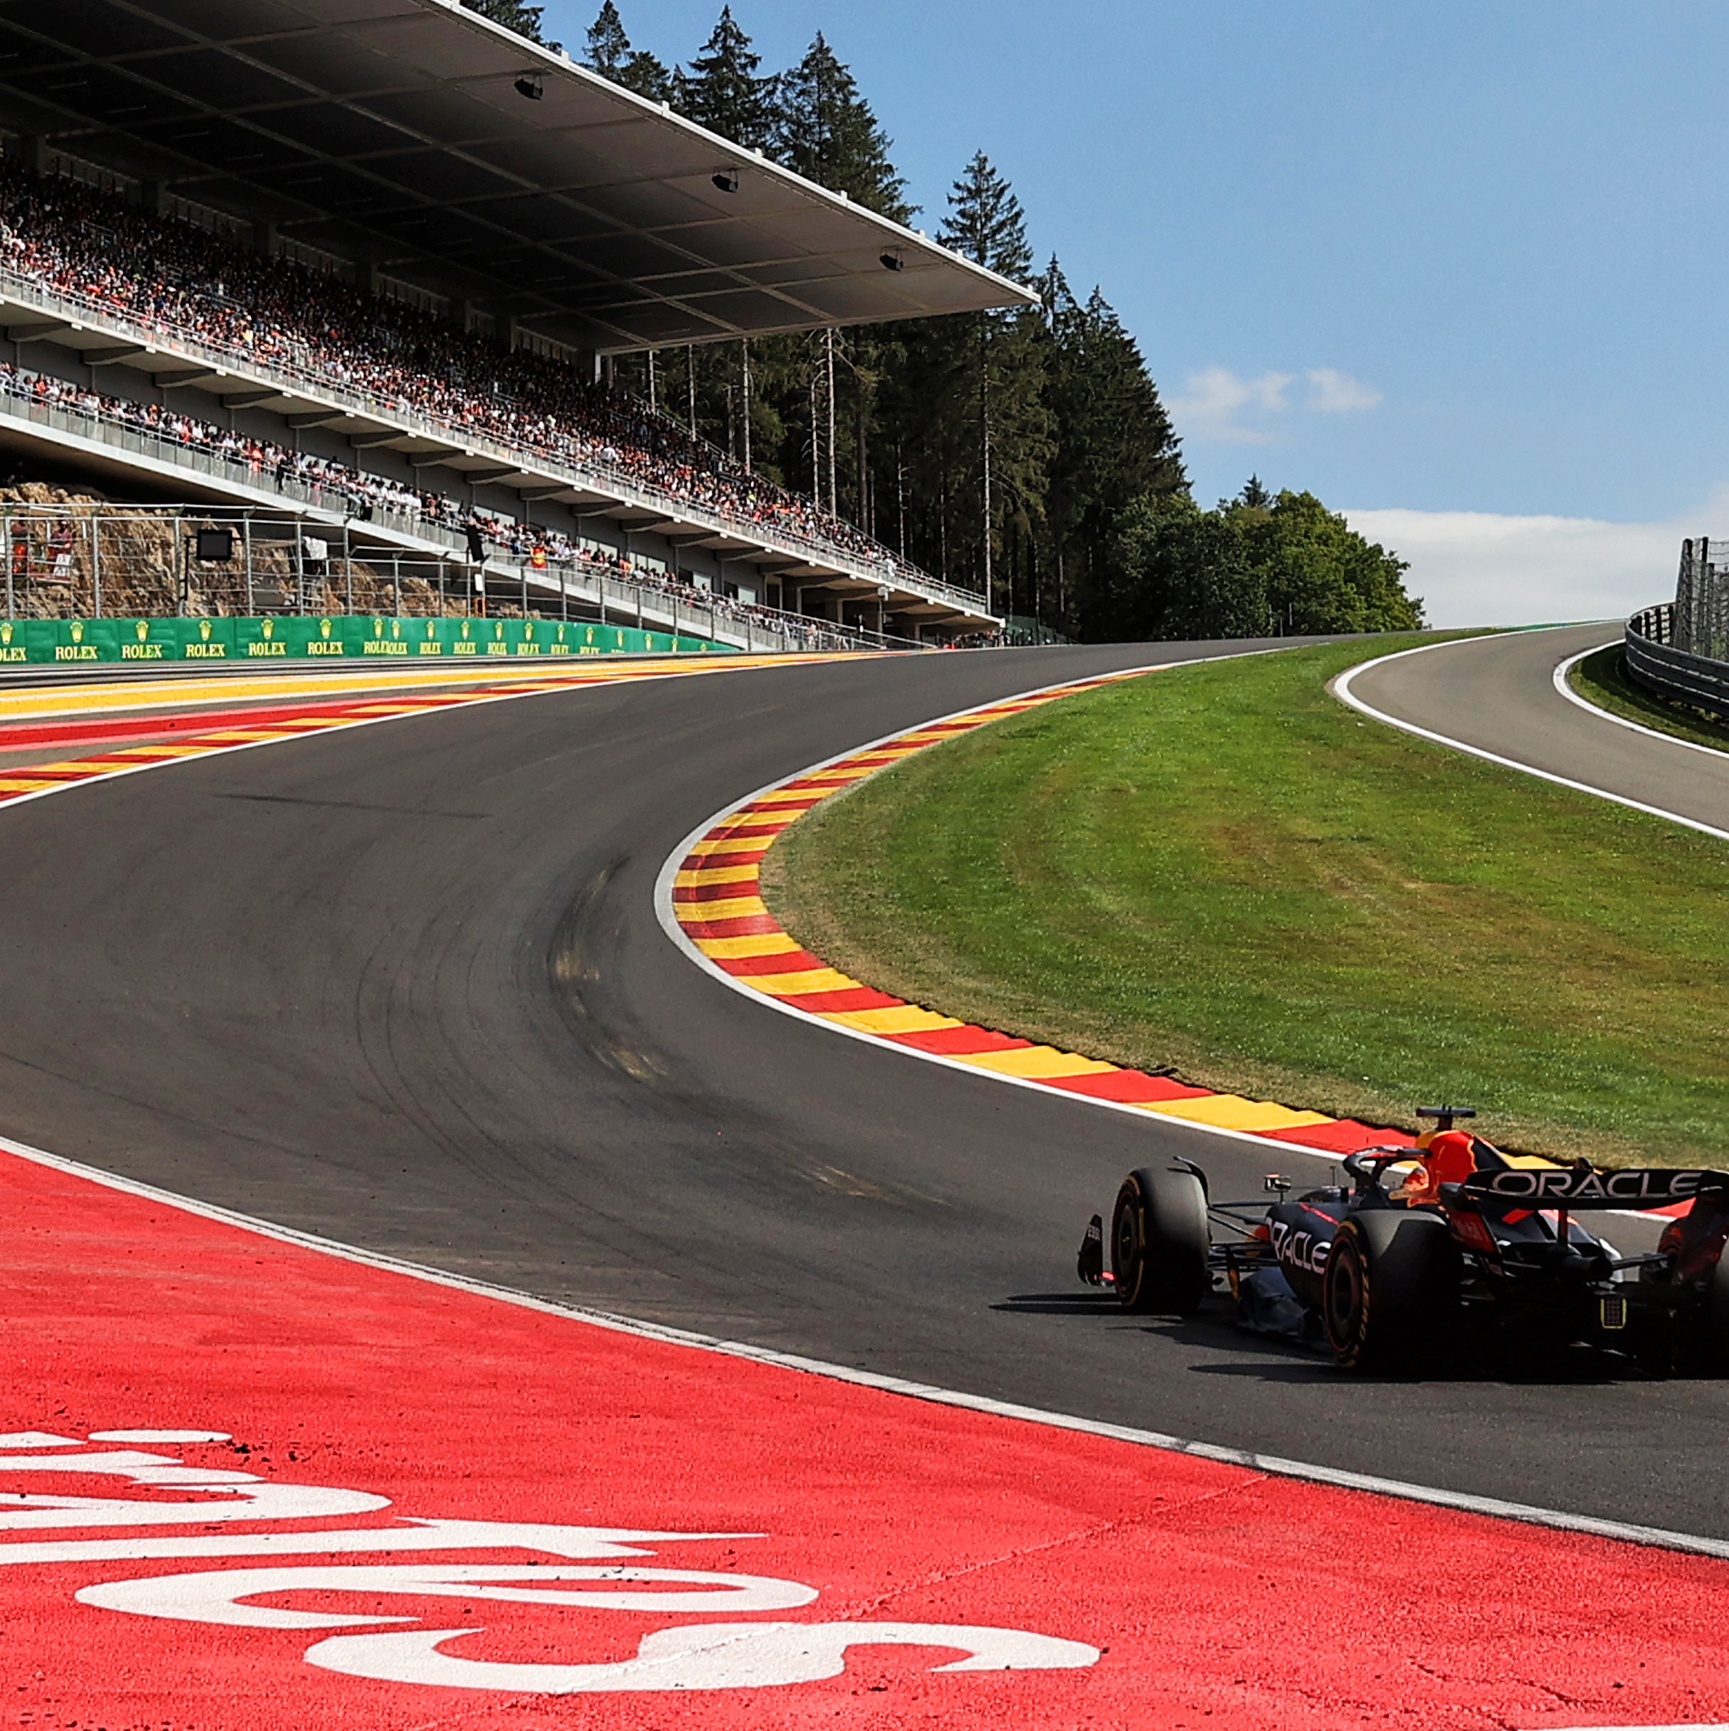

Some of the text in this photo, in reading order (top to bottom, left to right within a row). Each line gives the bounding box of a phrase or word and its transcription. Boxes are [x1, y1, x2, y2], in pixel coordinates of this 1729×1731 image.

[55, 645, 97, 660] ROLEX
[122, 644, 162, 659] ROLEX
[186, 644, 226, 657] ROLEX
[248, 642, 287, 656] ROLEX
[308, 642, 343, 655] ROLEX
[364, 641, 388, 654] ROLE
[388, 642, 408, 654] OLEX
[419, 642, 441, 654] ROLEX
[454, 642, 476, 654] ROLEX
[487, 642, 507, 655] ROLEX
[1491, 1171, 1704, 1198] ORACLE
